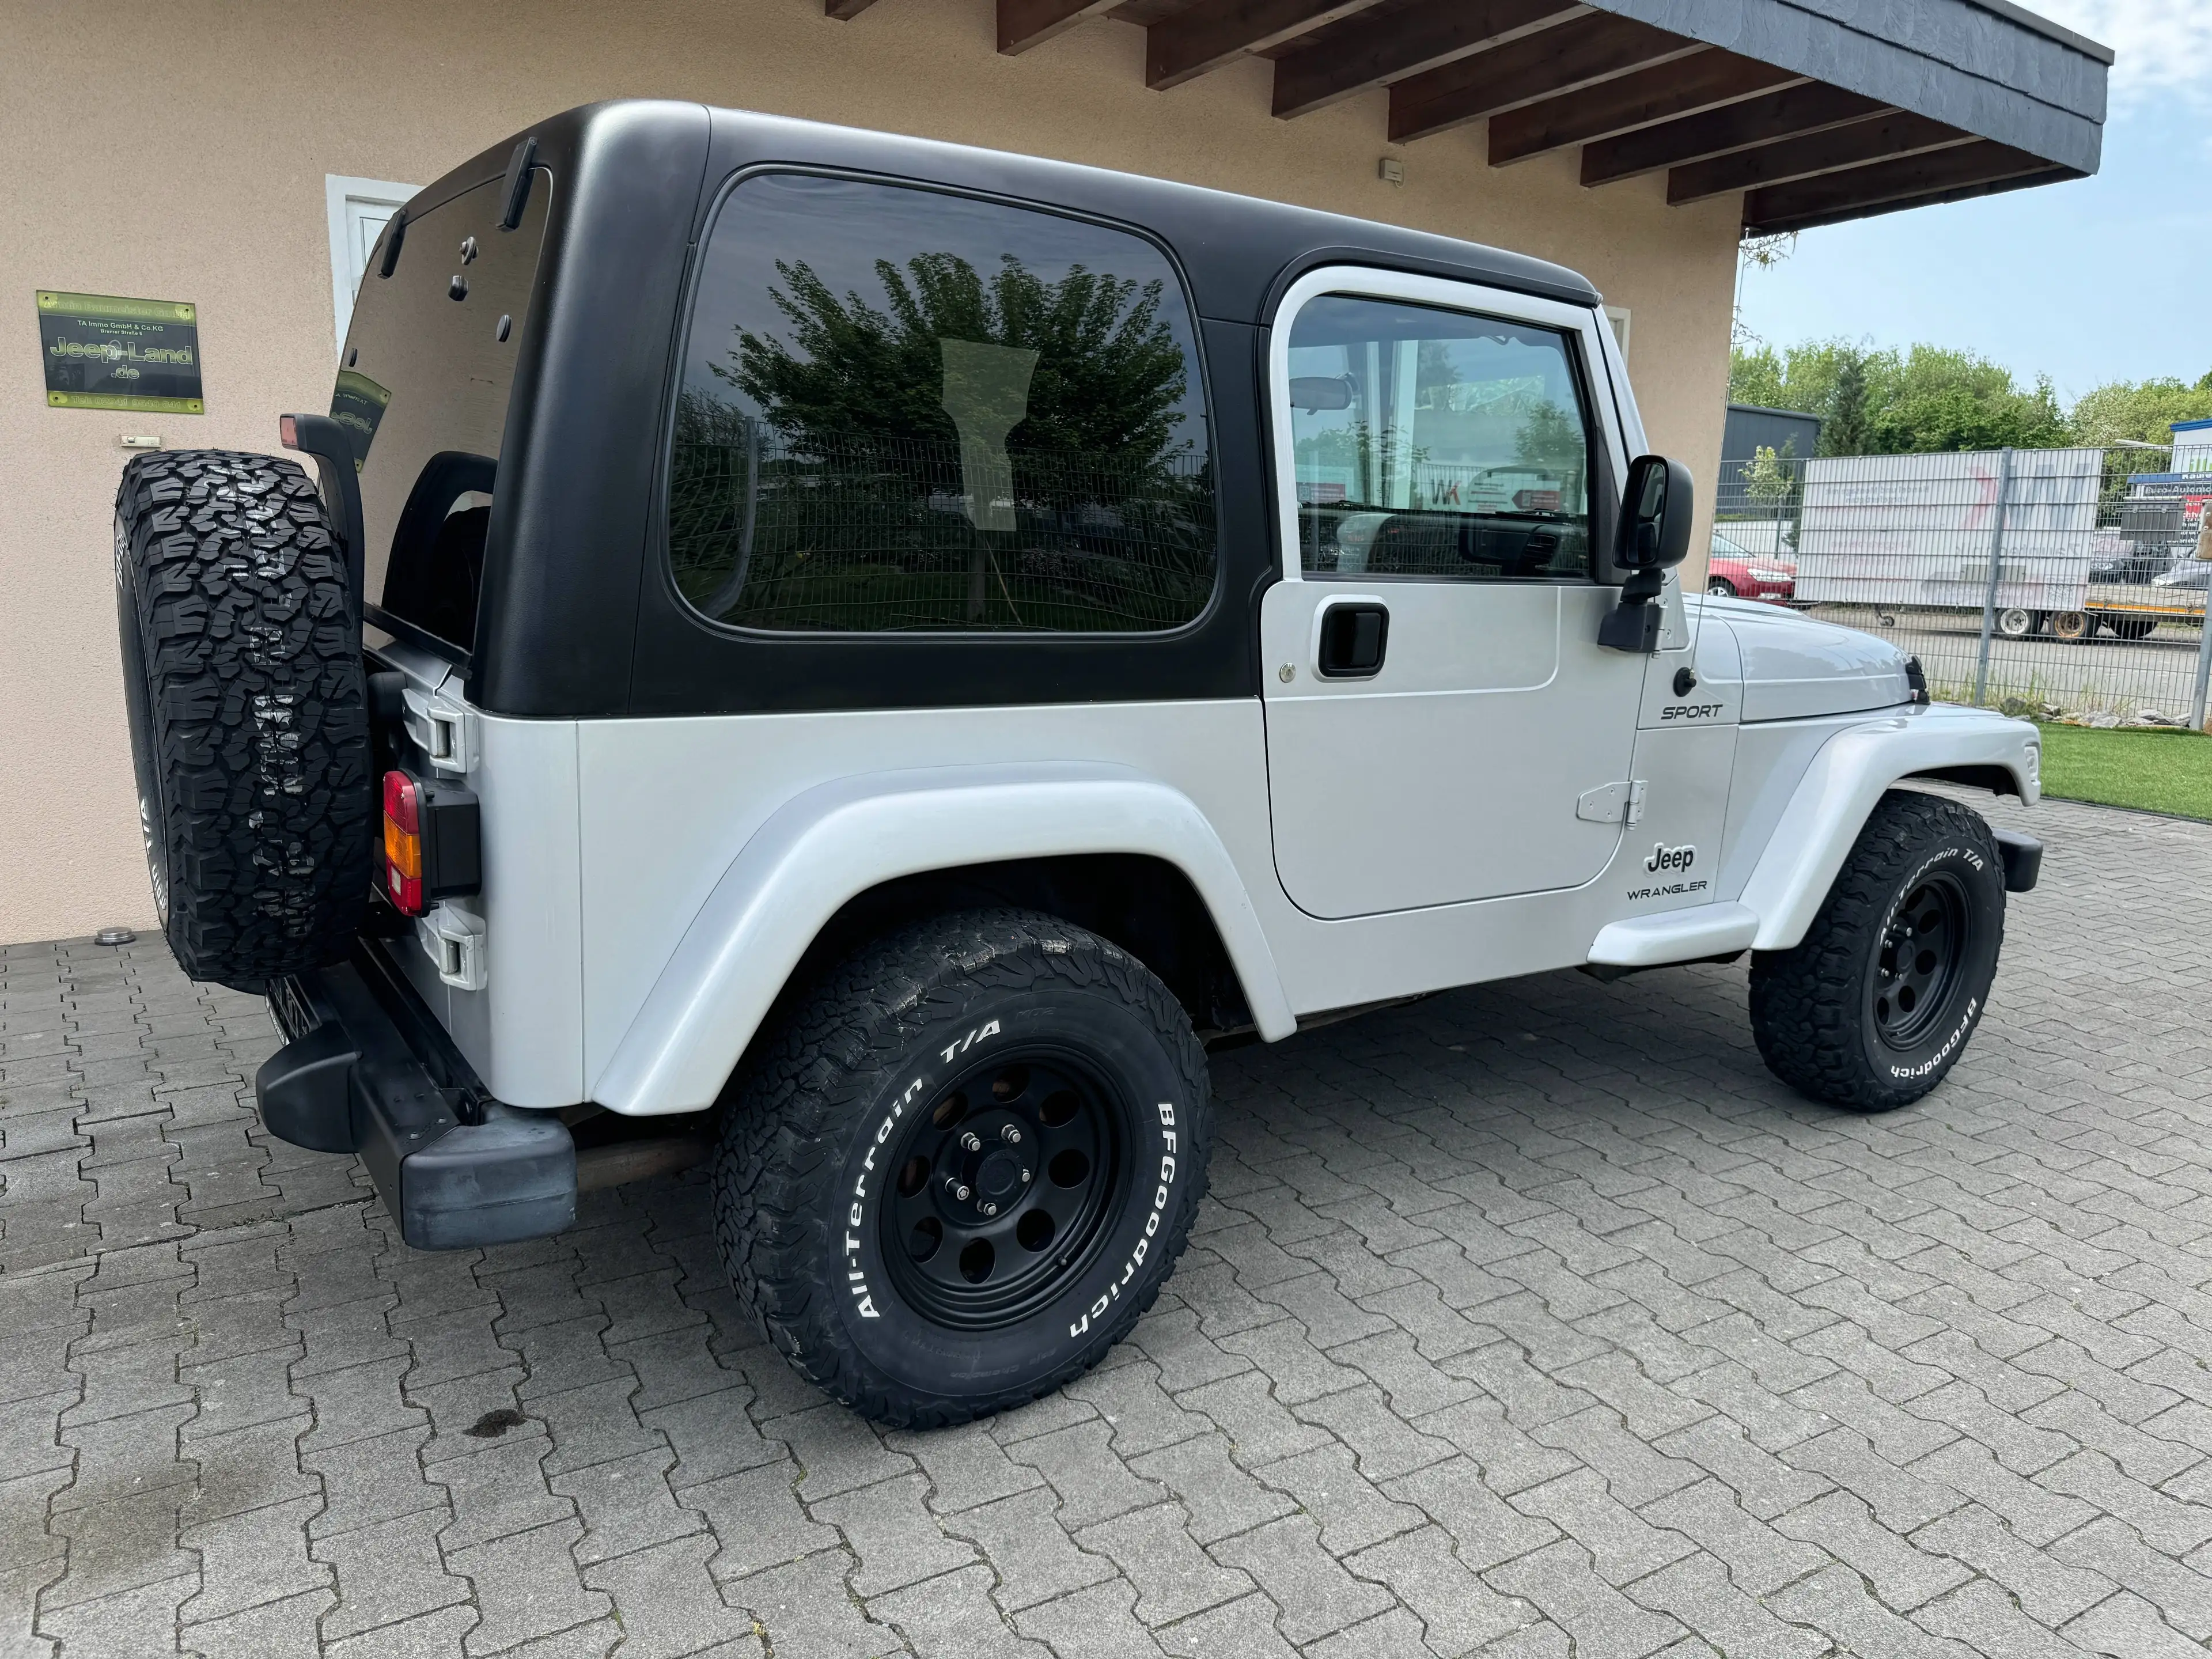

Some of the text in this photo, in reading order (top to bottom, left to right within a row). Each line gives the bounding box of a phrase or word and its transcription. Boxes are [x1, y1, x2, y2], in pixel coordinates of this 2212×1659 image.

[110, 322, 132, 330] GmbH
[50, 336, 193, 365] Jeep-Land
[111, 365, 140, 379] .de
[1660, 704, 1723, 720] SPORT
[1646, 845, 1695, 874] Jeep
[1963, 848, 1984, 872] T/A
[1627, 880, 1707, 900] WRANGLER
[1891, 997, 1977, 1080] BFGoodrich
[845, 1078, 922, 1318] All-Terrain
[940, 1020, 1001, 1063] T/A
[1069, 1103, 1177, 1338] BFGoodrich
